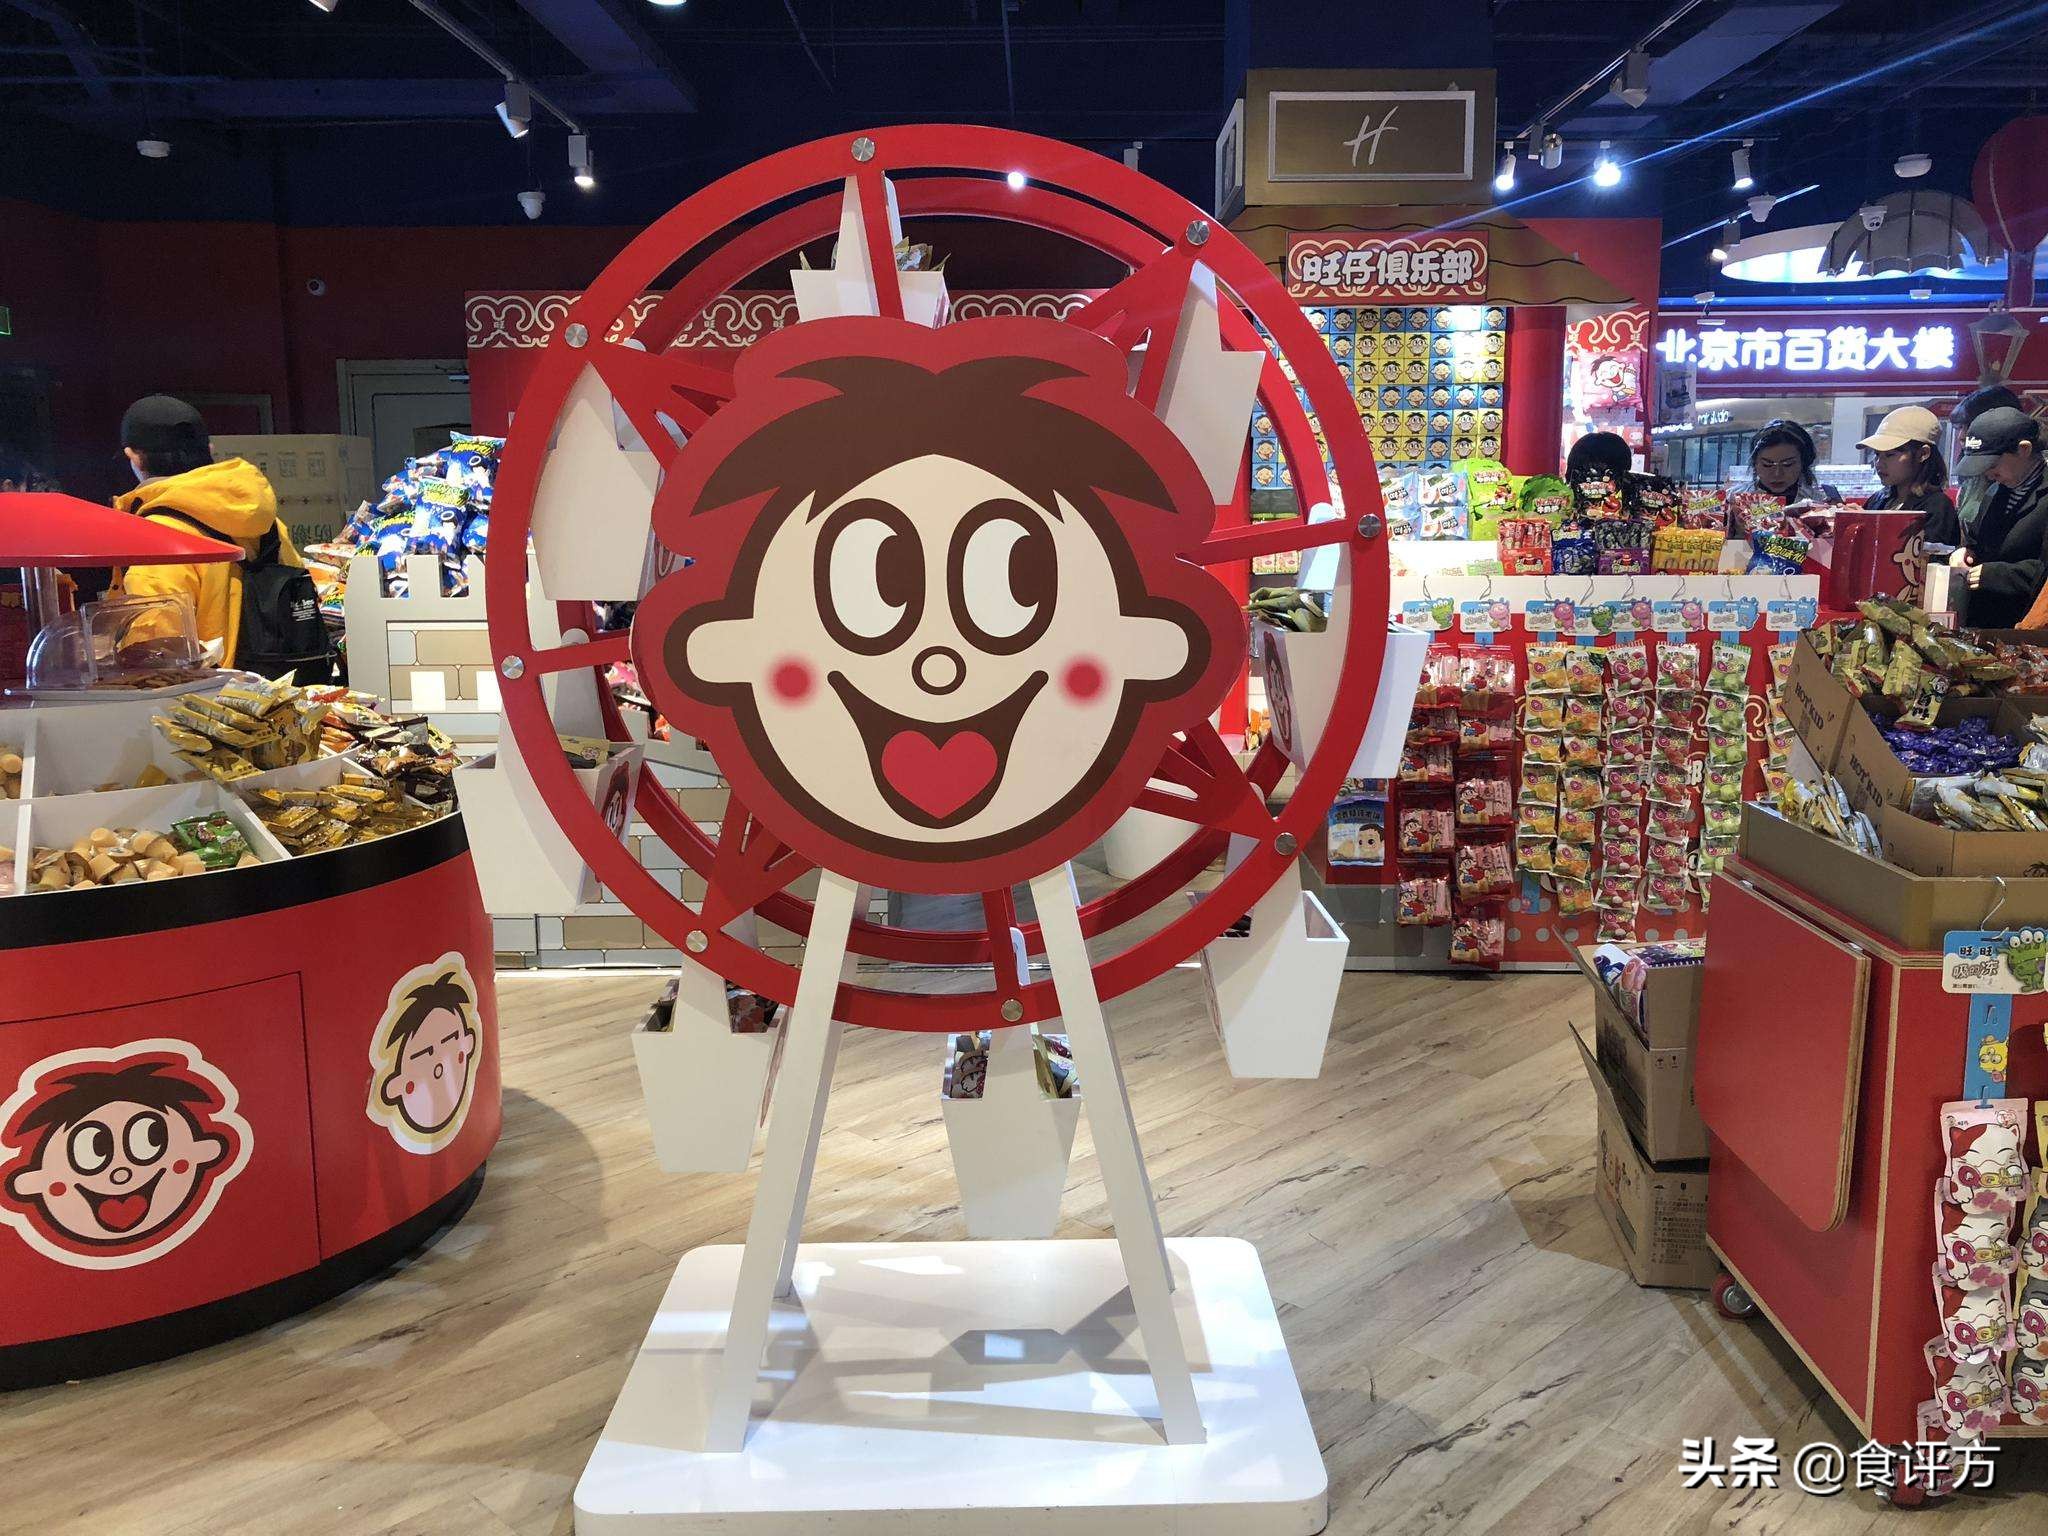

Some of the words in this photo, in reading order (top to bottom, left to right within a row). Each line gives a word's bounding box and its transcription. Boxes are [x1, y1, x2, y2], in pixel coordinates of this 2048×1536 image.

[1343, 105, 1399, 168] H
[1301, 249, 1473, 286] 旺仔俱乐部
[1808, 703, 1824, 730] KID
[1849, 753, 1870, 784] HOT
[1866, 779, 1883, 808] KID
